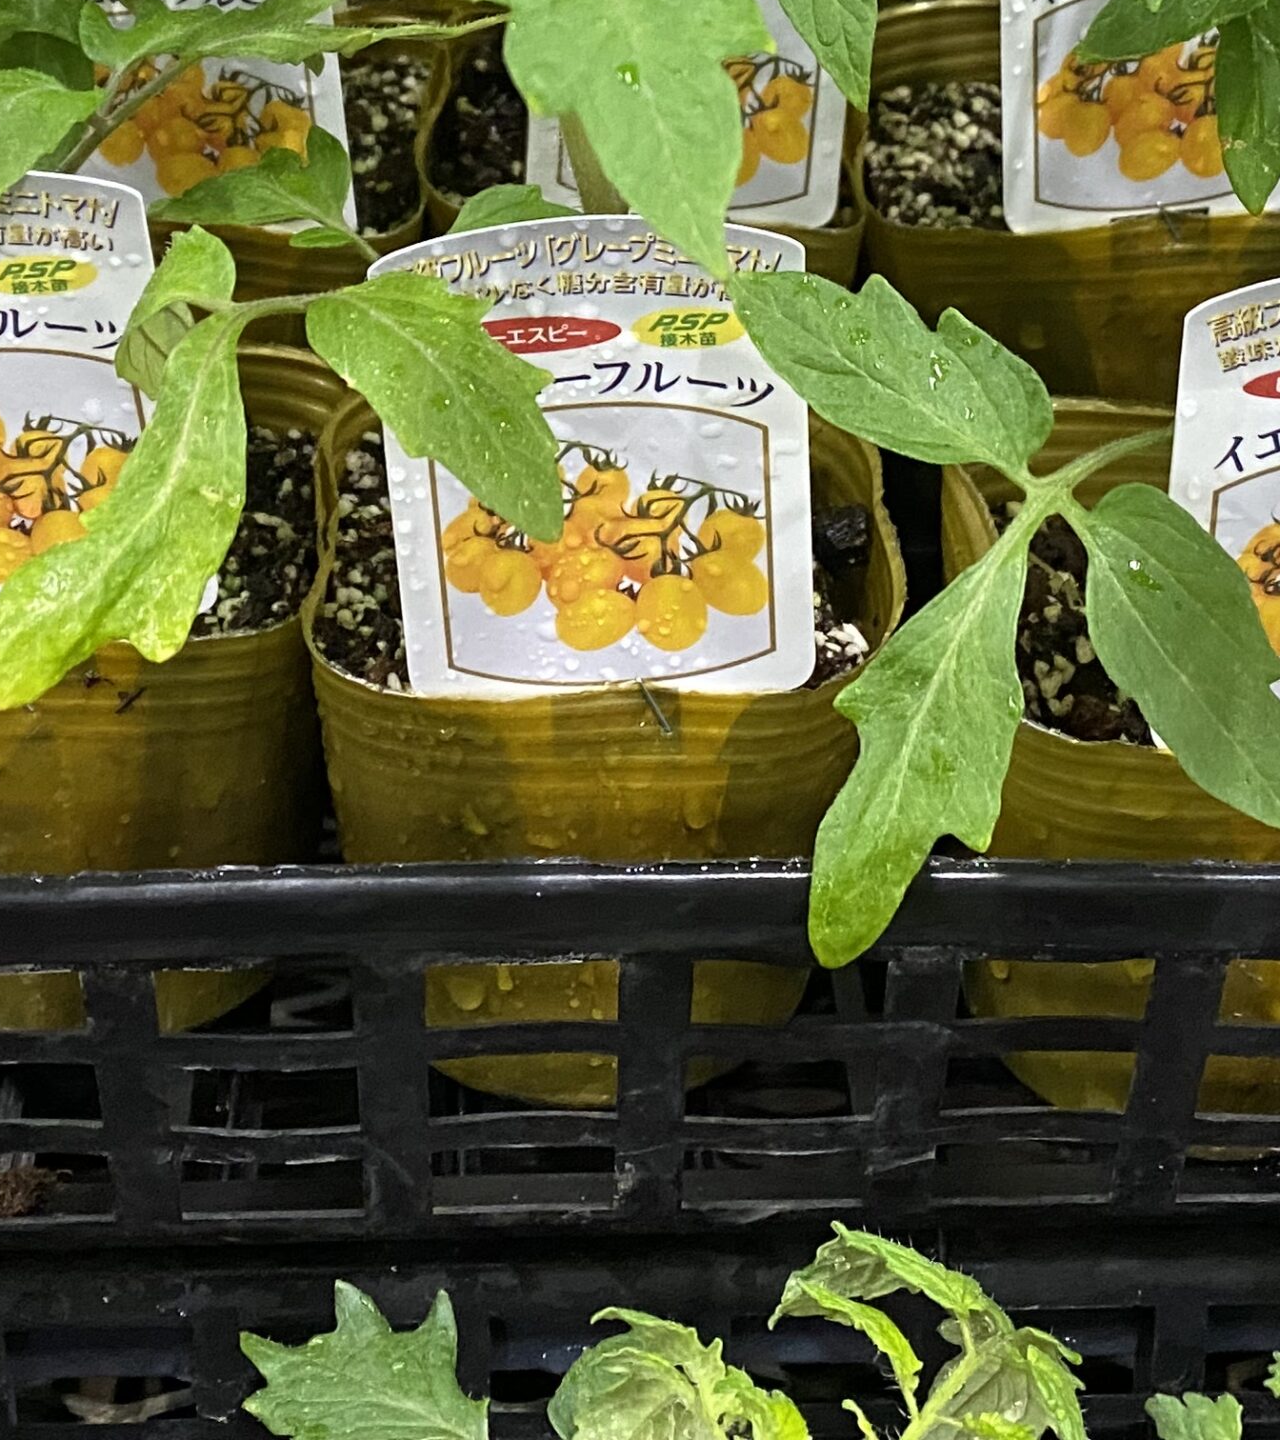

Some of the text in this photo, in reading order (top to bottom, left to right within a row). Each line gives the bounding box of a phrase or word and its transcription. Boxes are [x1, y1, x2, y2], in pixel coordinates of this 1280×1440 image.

[491, 324, 588, 345] ーエスピー
[659, 331, 717, 348] 接木苗
[553, 360, 775, 407] ーフルーツ
